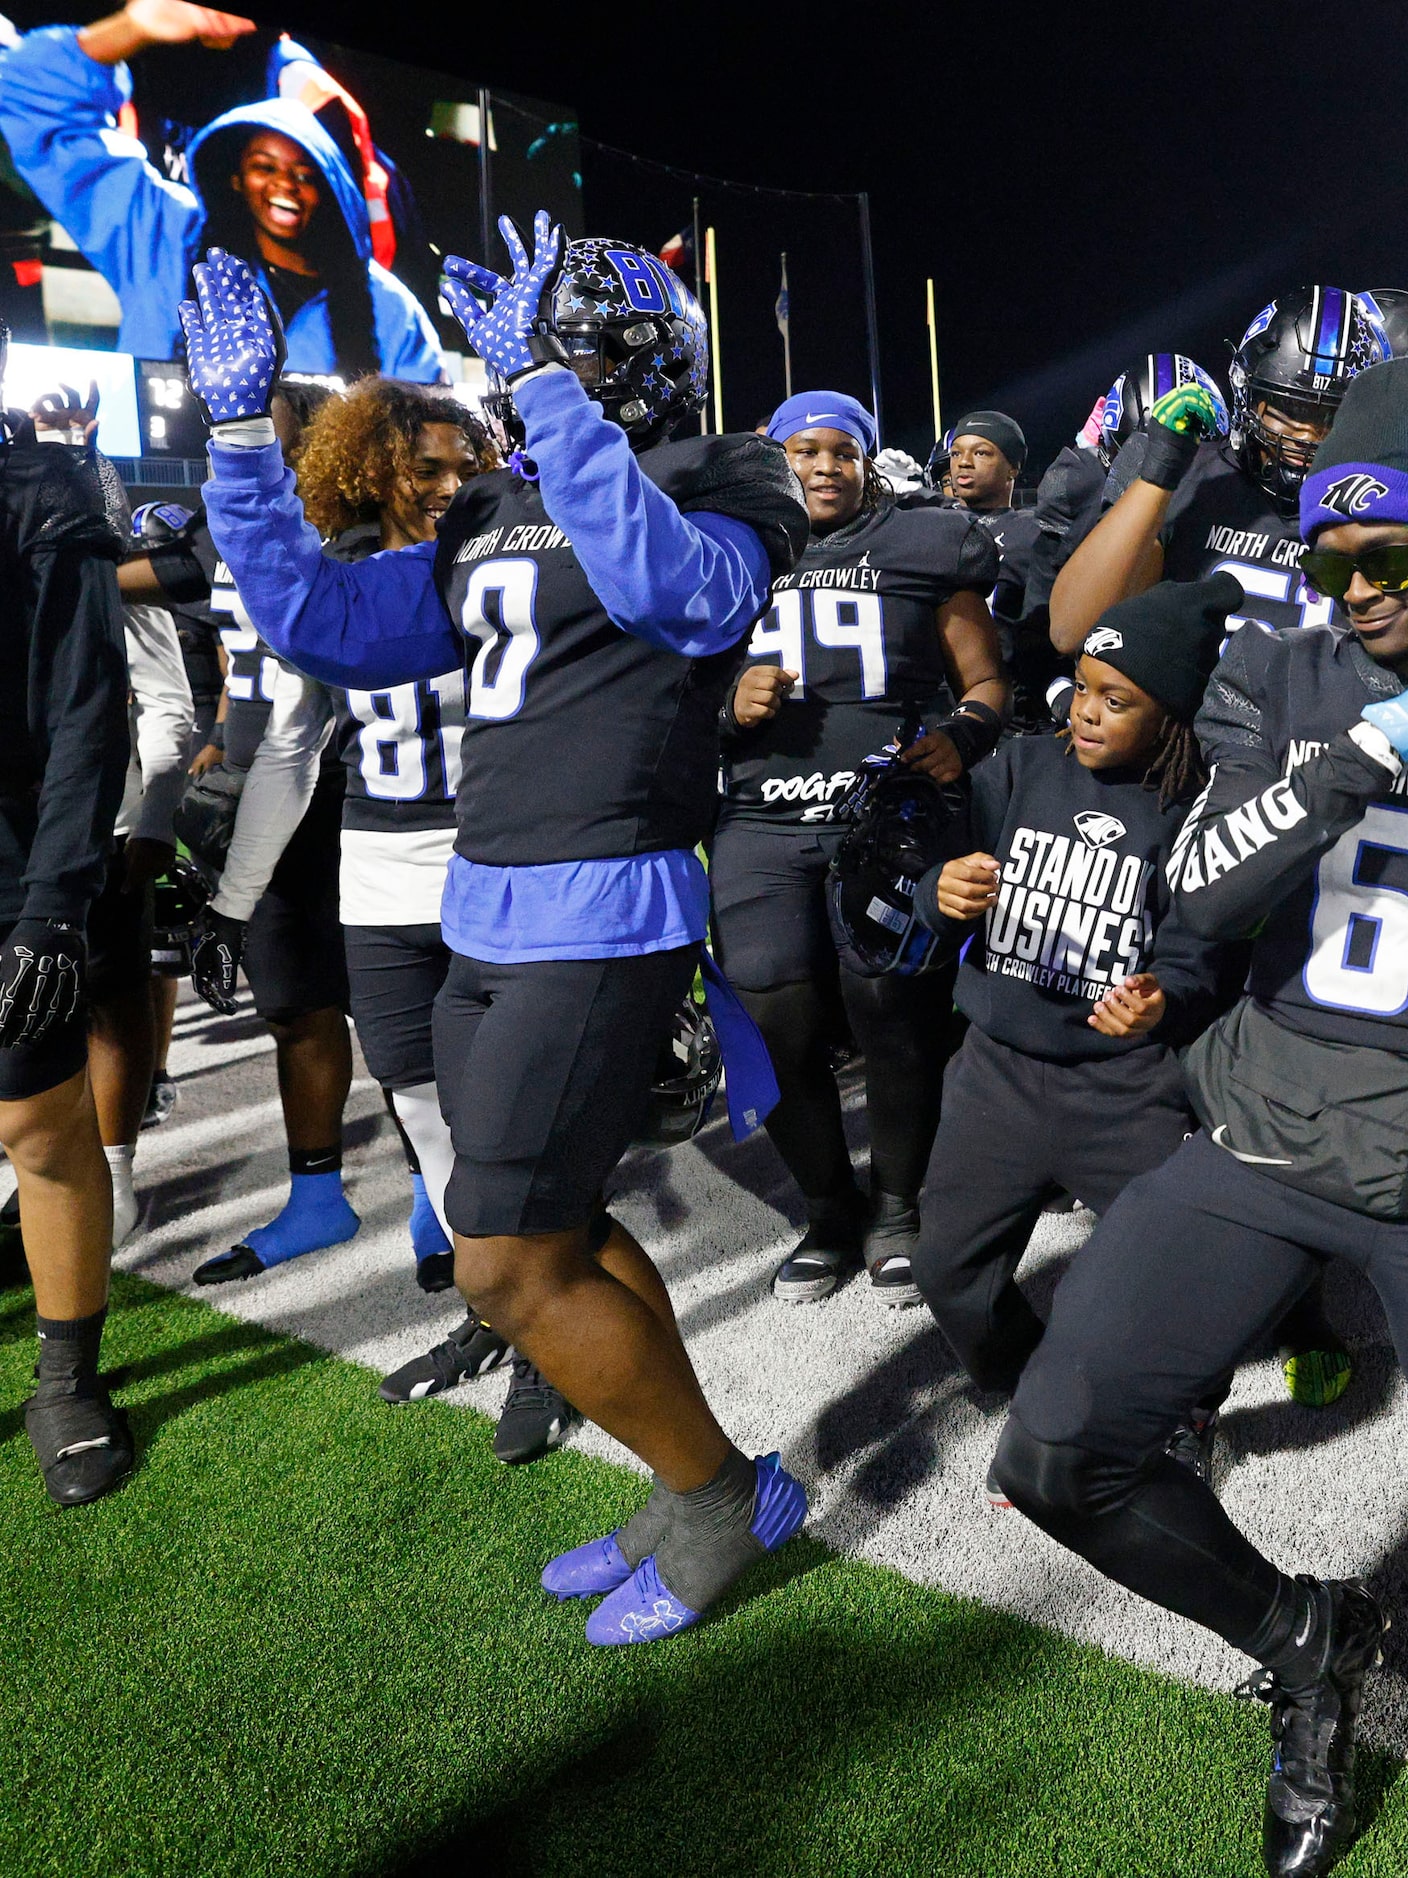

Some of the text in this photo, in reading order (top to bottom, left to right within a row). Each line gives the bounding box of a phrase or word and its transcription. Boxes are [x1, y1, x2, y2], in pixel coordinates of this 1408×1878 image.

[1319, 473, 1390, 517] NC
[452, 527, 505, 565] NORTH
[1205, 524, 1270, 559] NORTH
[798, 567, 882, 591] CROWLEY
[461, 557, 541, 721] 0
[747, 588, 889, 701] 99
[346, 668, 466, 801] 81
[1002, 827, 1119, 908] STAND
[985, 883, 1149, 986] USINES
[1001, 957, 1055, 988] CROWLEY
